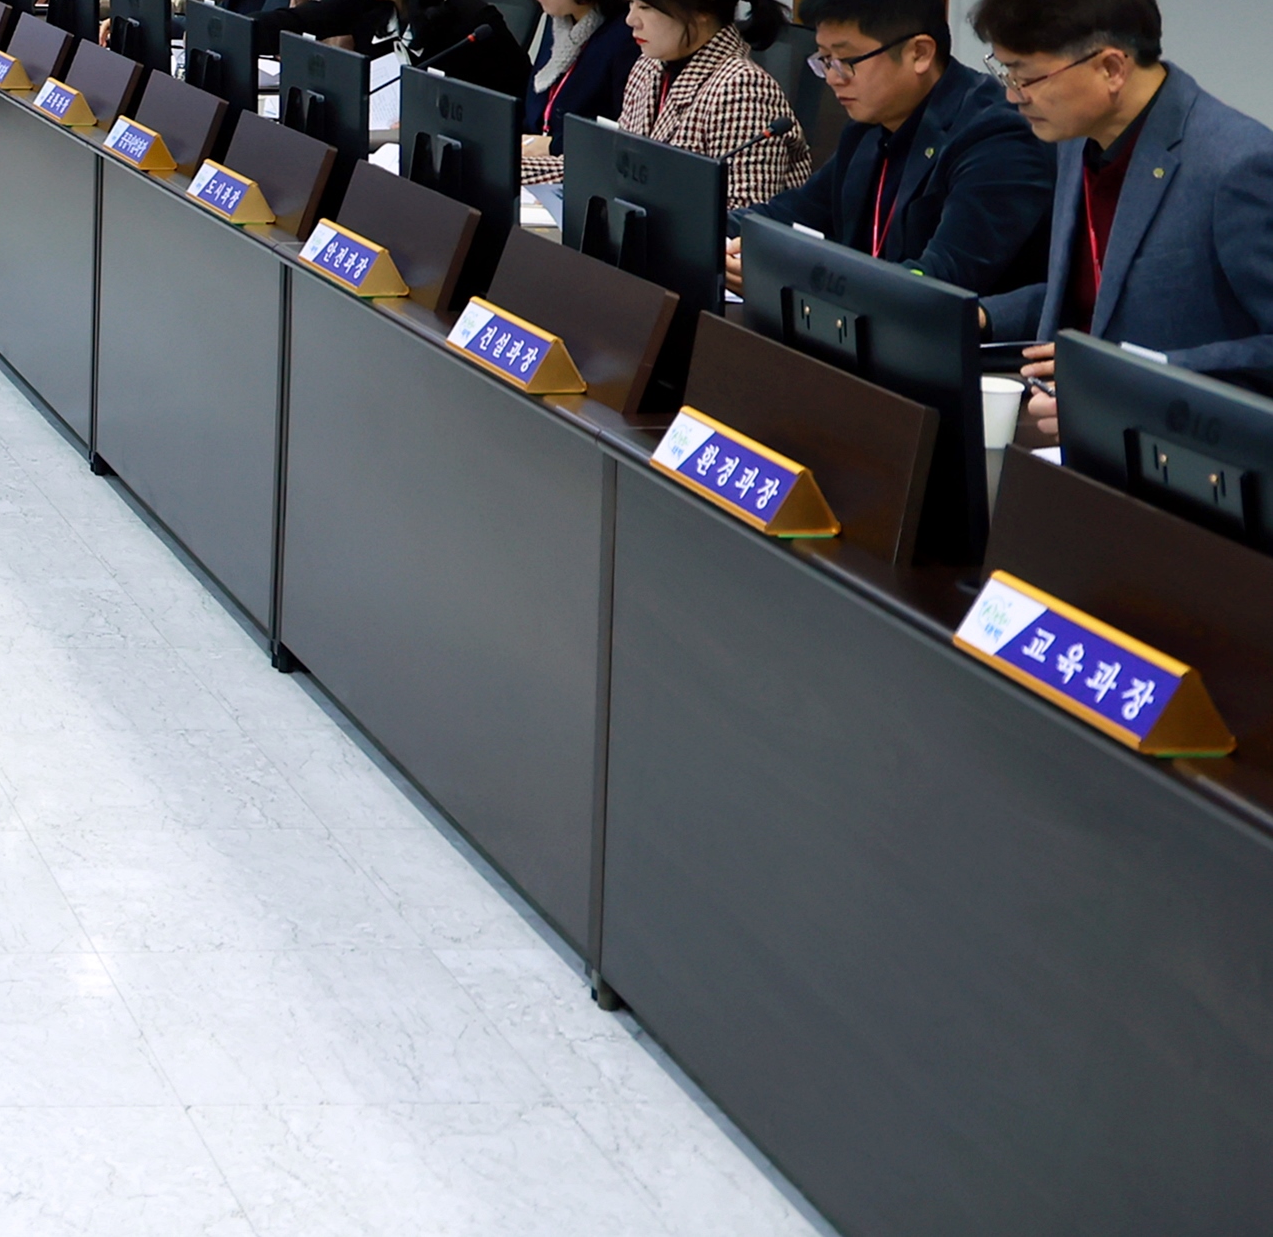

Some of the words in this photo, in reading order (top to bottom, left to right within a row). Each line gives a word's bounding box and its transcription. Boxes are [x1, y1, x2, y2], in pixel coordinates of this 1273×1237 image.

[631, 163, 649, 184] LG
[205, 179, 242, 209] 도시과장
[322, 241, 370, 279] 안전과장
[826, 272, 847, 297] LG
[479, 325, 539, 373] 건설과장
[1192, 412, 1222, 447] LG
[696, 444, 781, 510] 환경과장
[1021, 626, 1156, 721] 교육과장
